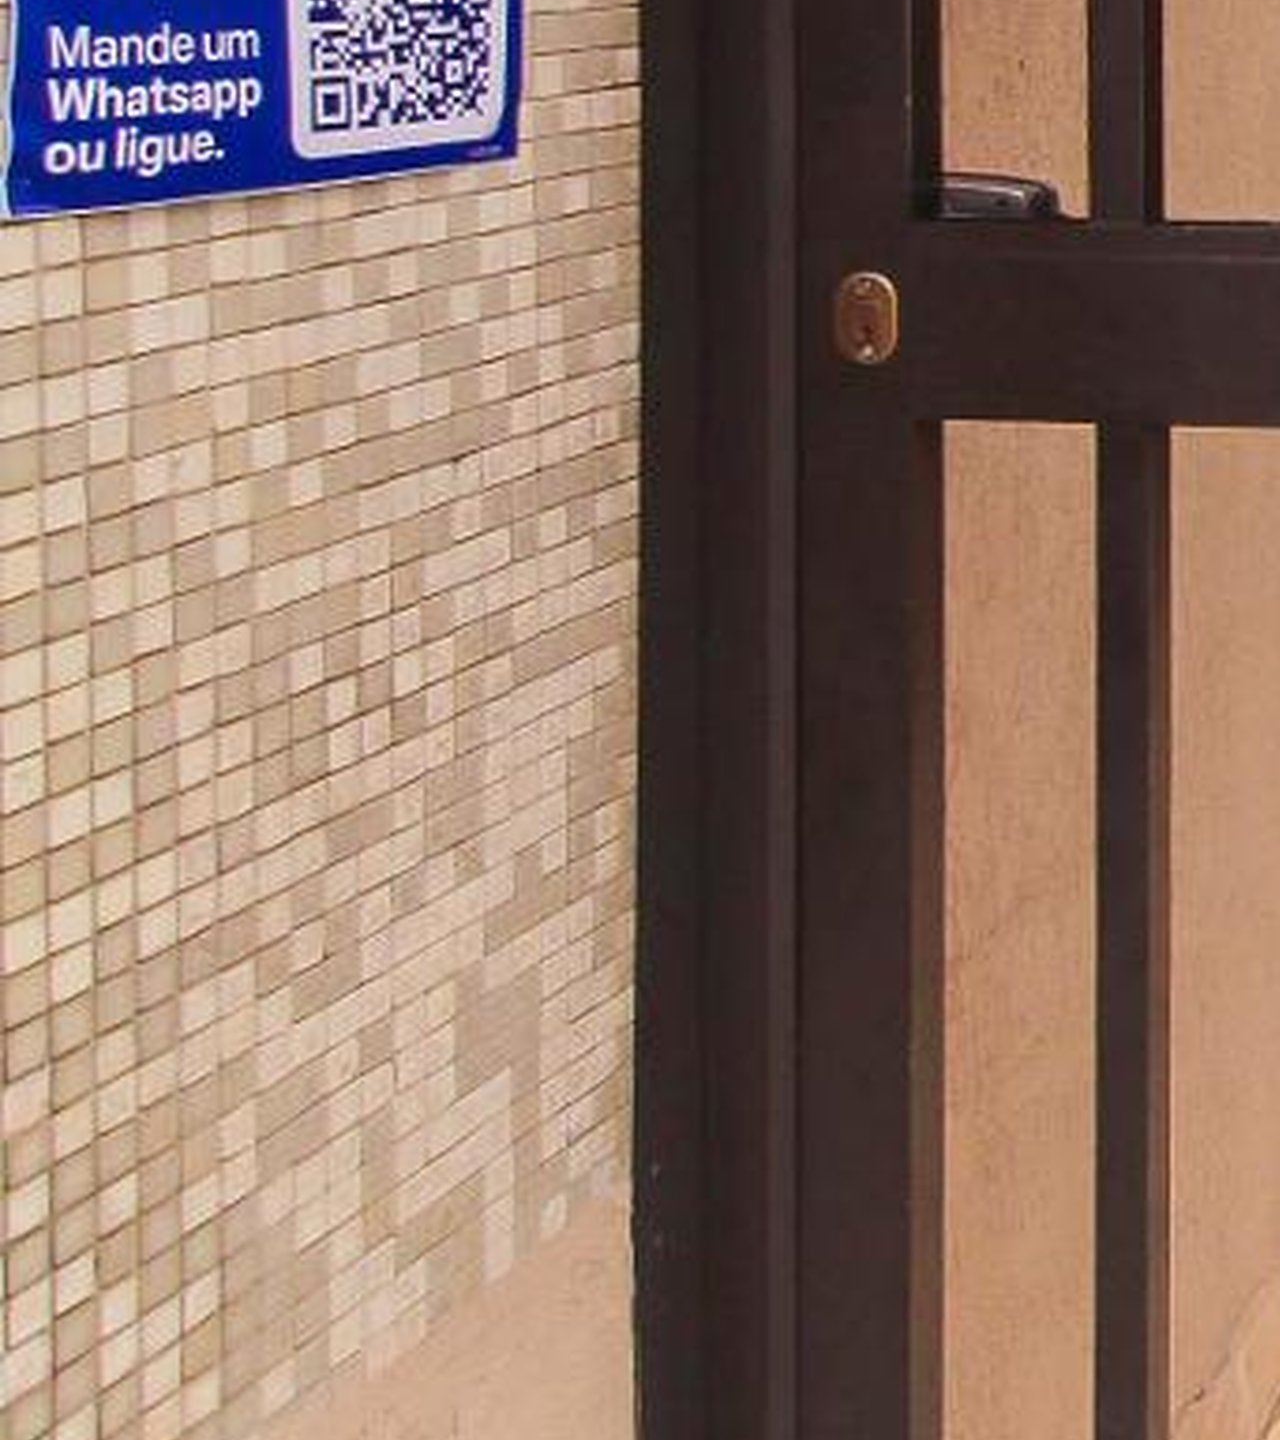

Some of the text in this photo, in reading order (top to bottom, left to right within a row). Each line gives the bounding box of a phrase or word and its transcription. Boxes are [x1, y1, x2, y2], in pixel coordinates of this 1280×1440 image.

[48, 22, 261, 69] Mande um
[47, 76, 262, 122] Whatsapp
[44, 126, 224, 177] ou ligue.
